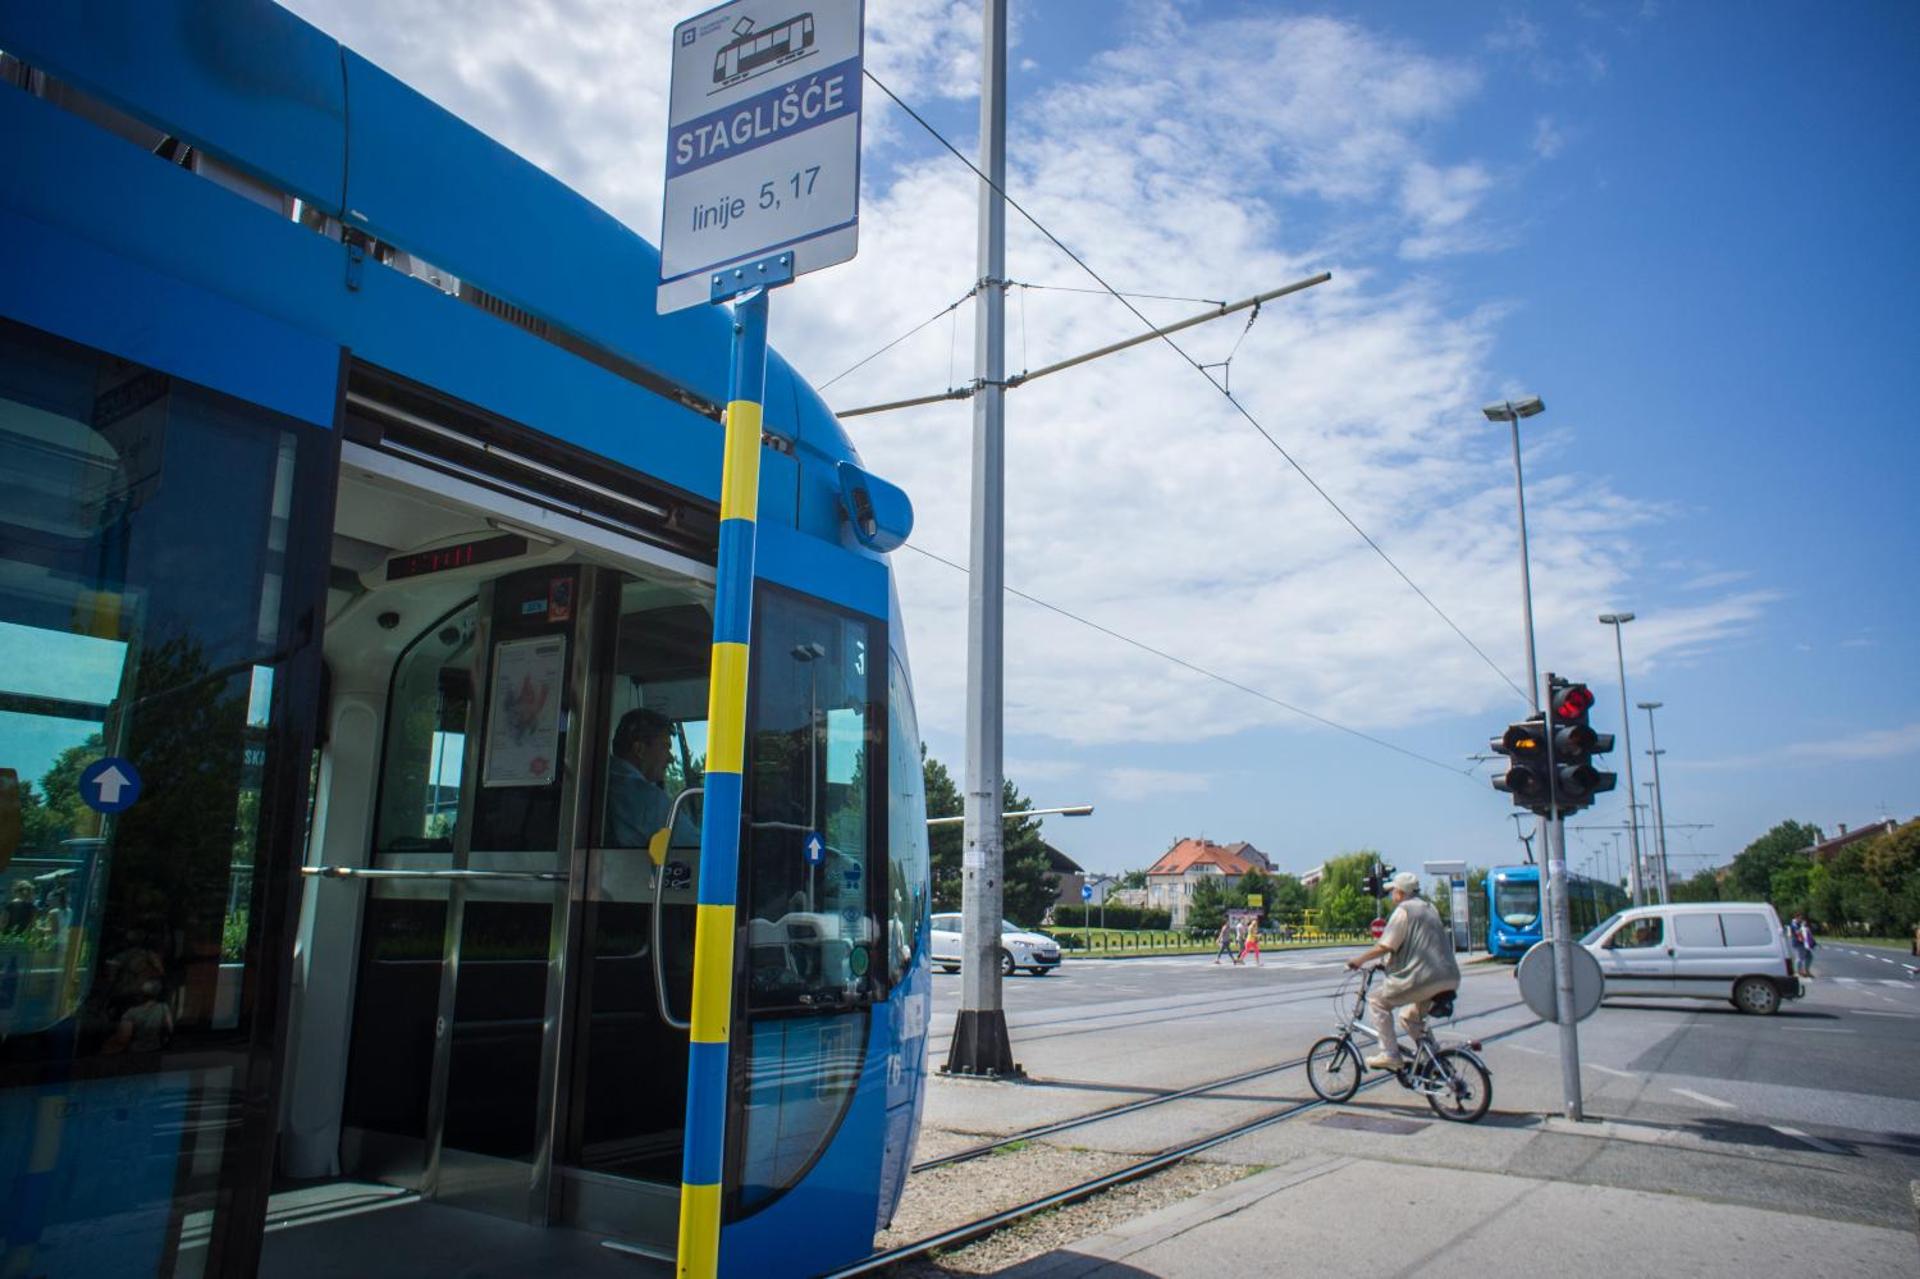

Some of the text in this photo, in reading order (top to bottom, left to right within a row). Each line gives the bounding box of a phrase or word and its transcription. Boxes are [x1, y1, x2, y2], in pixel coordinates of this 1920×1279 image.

[676, 76, 844, 165] STAGLIŠĆE
[692, 166, 821, 232] linije 5, 17
